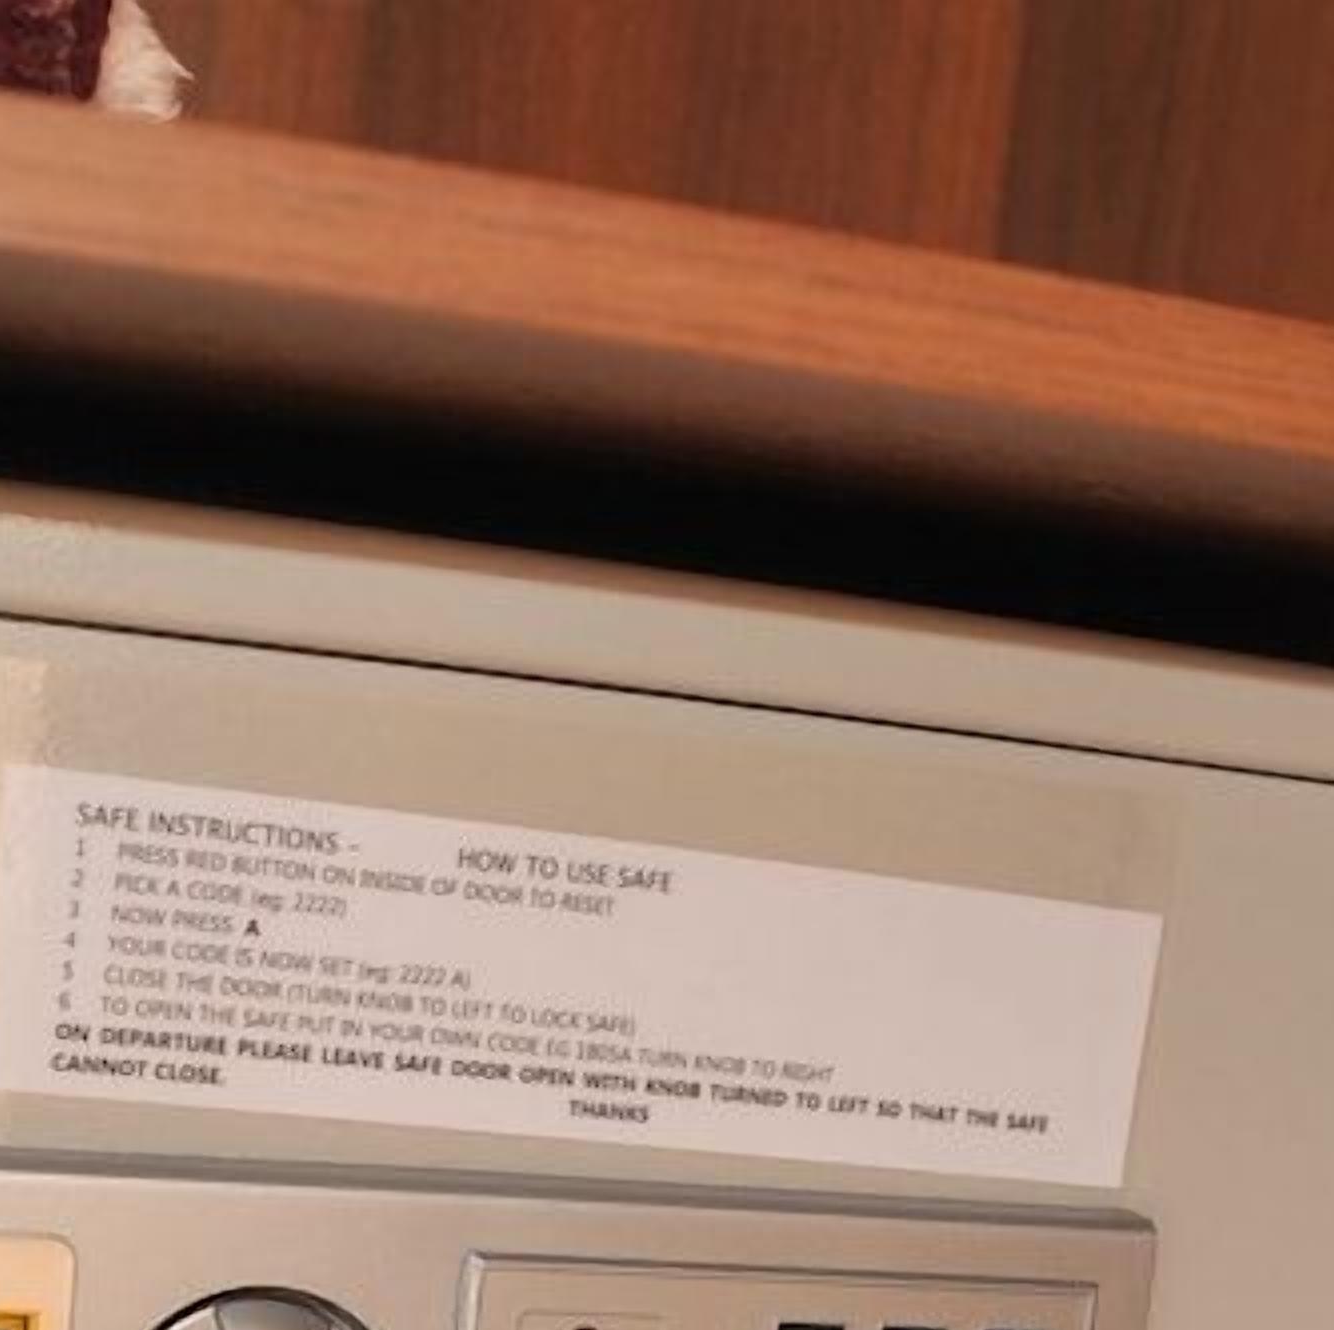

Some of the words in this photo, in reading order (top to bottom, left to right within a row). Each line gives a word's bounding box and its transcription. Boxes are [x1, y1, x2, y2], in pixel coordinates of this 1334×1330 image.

[75, 802, 139, 832] SAFE
[148, 812, 340, 855] INSTRUCTIONS
[114, 873, 159, 896] PICK
[187, 881, 243, 905] CODE
[117, 842, 178, 868] PRESS
[185, 849, 226, 871] RED
[231, 855, 315, 882] BUTTON
[322, 864, 354, 886] ON
[359, 869, 425, 893] INSIDE
[431, 878, 457, 896] OF
[464, 880, 522, 904] DOOR
[530, 887, 556, 909] TO
[560, 892, 614, 917] RESET
[457, 848, 516, 874] HOW
[527, 855, 559, 880] TO
[567, 861, 609, 886] USE
[617, 868, 674, 895] SAFE
[111, 904, 165, 926] NOW
[171, 909, 233, 934] PRESS
[244, 917, 261, 936] A
[108, 934, 165, 957] YOUR
[171, 939, 228, 964] CODE
[235, 947, 254, 967] IS
[259, 950, 312, 973] NOW
[319, 955, 352, 978] SET
[104, 963, 166, 990] CLOSE
[177, 971, 212, 994] THE
[219, 975, 281, 999] DOOR
[287, 981, 350, 1008] (TURN
[357, 988, 413, 1012] KNOB
[420, 995, 447, 1017] TO
[451, 998, 493, 1020] LEFT
[500, 1004, 526, 1025] TO
[530, 1007, 580, 1030] LOCK
[101, 995, 130, 1016] TO
[135, 998, 192, 1023] OPEN
[199, 1005, 235, 1026] THE
[243, 1009, 290, 1035] SAFE
[298, 1014, 336, 1035] PUT
[341, 1019, 363, 1039] IN
[369, 1022, 424, 1044] YOUR
[430, 1027, 480, 1050] OWN
[487, 1034, 539, 1058] CODE
[639, 1047, 687, 1069] TURN
[694, 1053, 746, 1077] KNOB
[752, 1058, 776, 1081] TO
[782, 1060, 835, 1084] RIGHT
[49, 1051, 148, 1078] CANNOT
[54, 1022, 91, 1044] ON
[99, 1025, 227, 1056] DEPARTURE
[236, 1037, 312, 1064] PLEASE
[321, 1047, 384, 1071] LEAVE
[394, 1052, 442, 1077] SAFE
[450, 1058, 512, 1081] DOOR
[519, 1065, 574, 1088] OPEN
[583, 1070, 636, 1093] WITH
[644, 1076, 700, 1099] KNOB
[710, 1083, 789, 1108] TURNED
[796, 1090, 821, 1112] TO
[828, 1095, 868, 1115] LEFT
[876, 1100, 903, 1119] SO
[910, 1103, 959, 1125] THAT
[965, 1108, 998, 1129] THE
[1006, 1111, 1050, 1135] SAFE
[569, 1098, 649, 1125] THANKS
